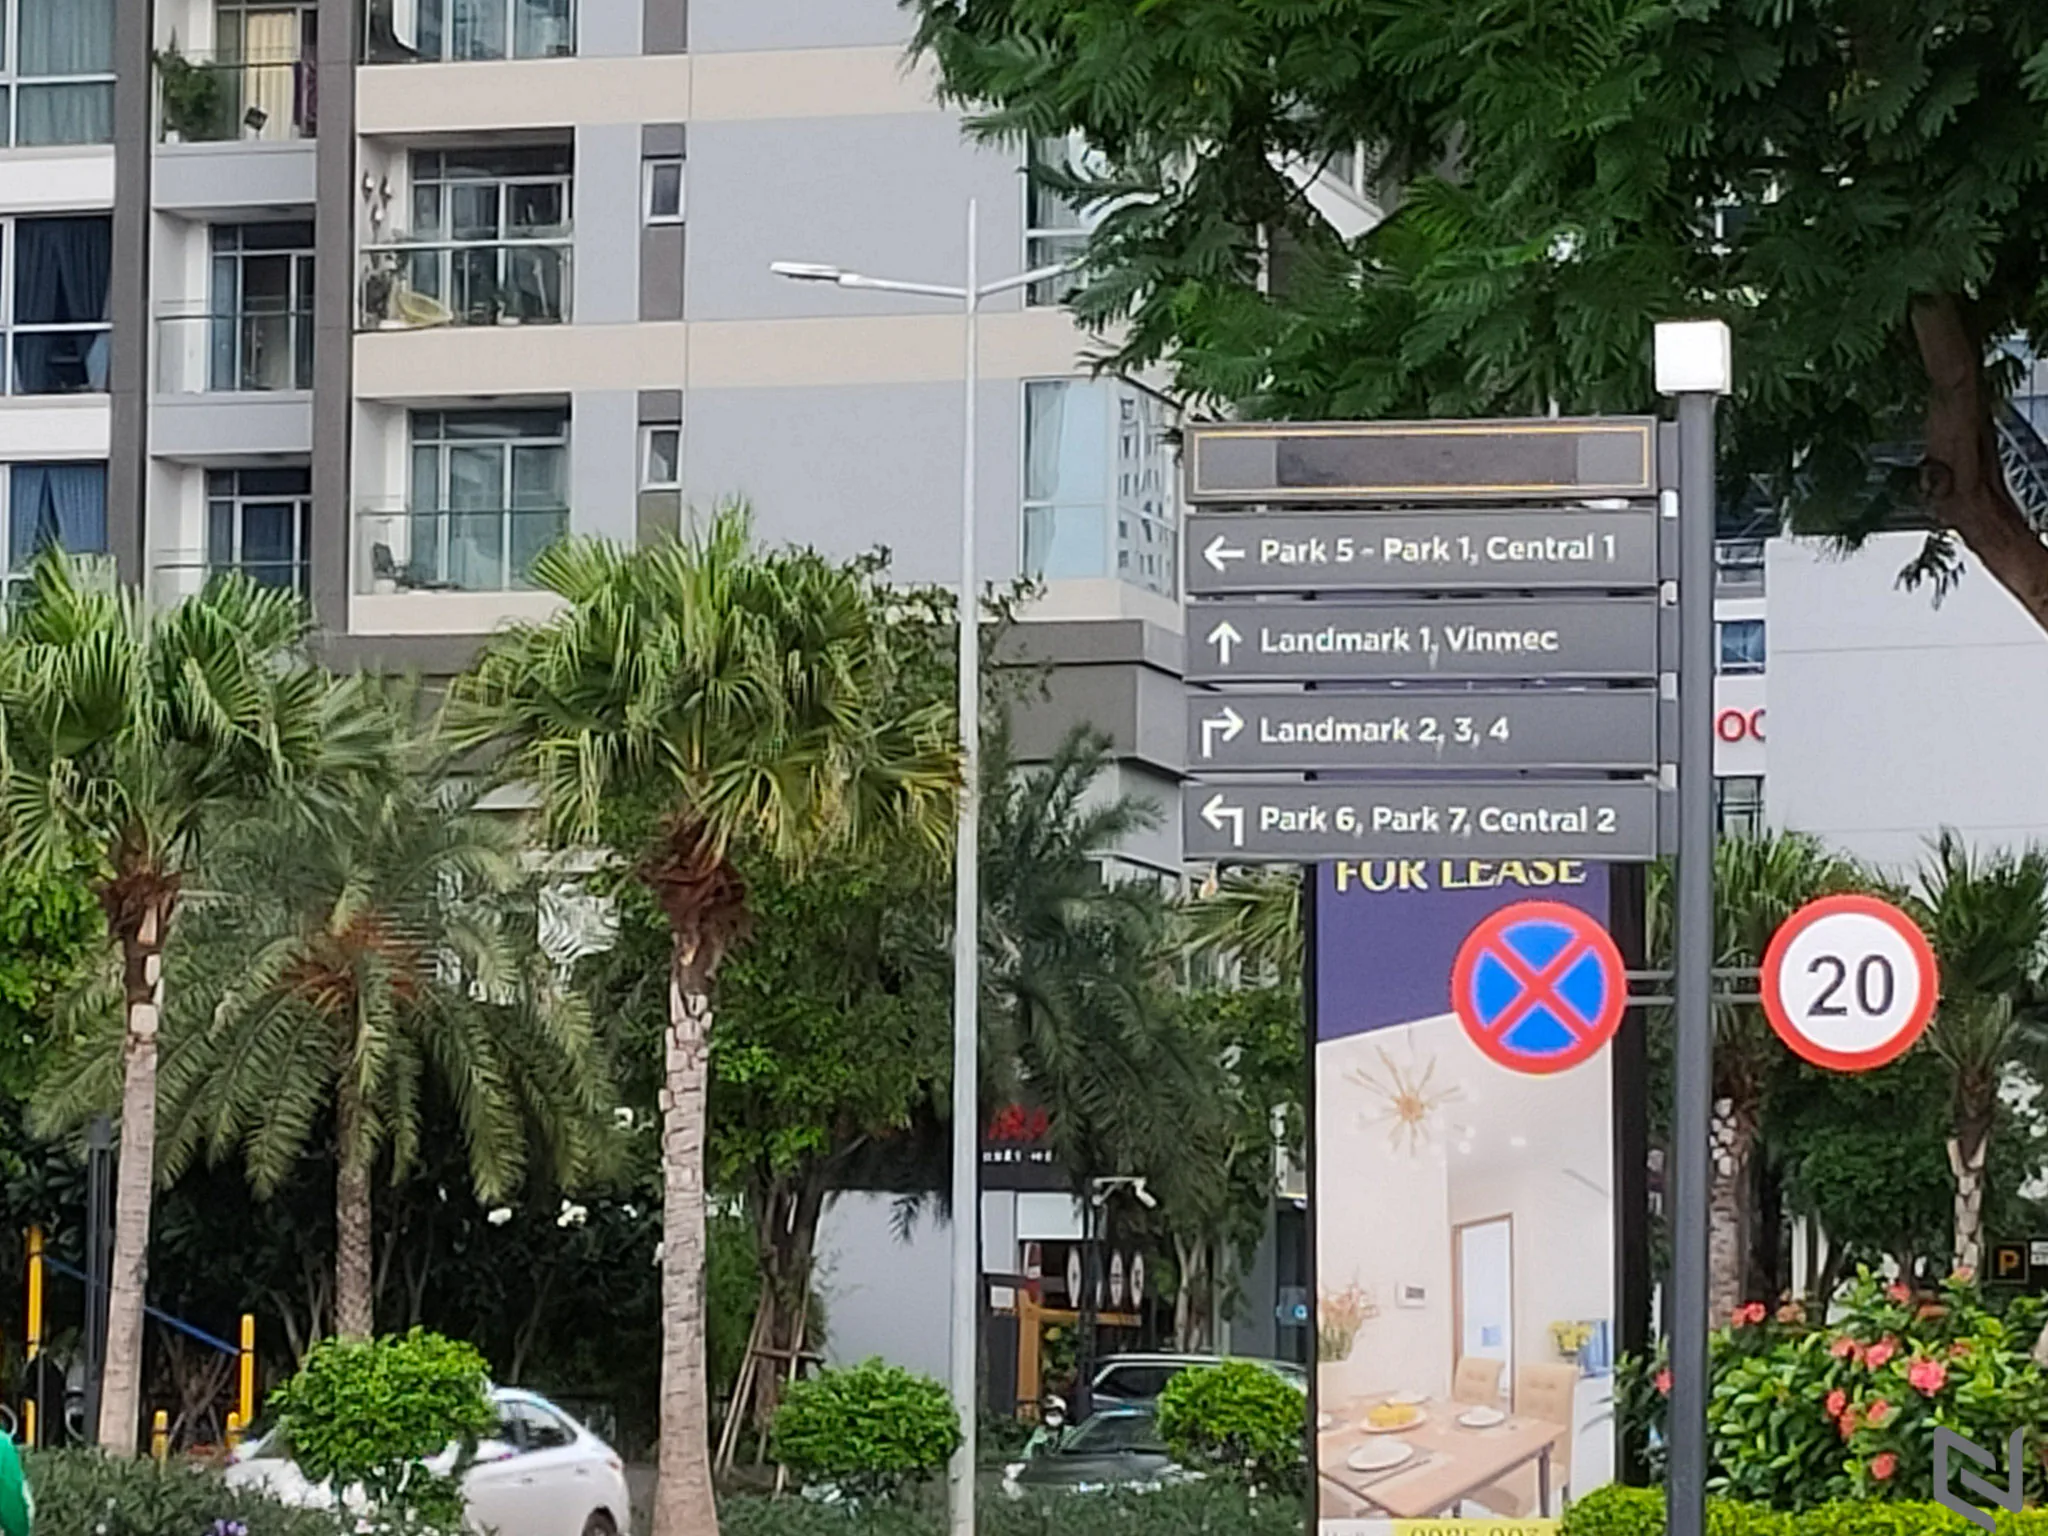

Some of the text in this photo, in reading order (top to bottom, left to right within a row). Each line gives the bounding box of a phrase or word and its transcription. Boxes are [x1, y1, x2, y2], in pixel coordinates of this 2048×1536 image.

[1261, 538, 1327, 563] Park
[1336, 538, 1354, 562] 5
[1384, 536, 1450, 562] Park
[1457, 536, 1479, 565] 1,
[1486, 535, 1594, 560] Central
[1603, 534, 1615, 560] 1
[1261, 625, 1559, 656] Landmark 1, Vinmec
[1261, 716, 1509, 748] Landmark 2, 3, 4
[1261, 805, 1616, 837] Park 6, Park 7, Central 2
[1336, 859, 1588, 892] FOR LEASE
[1806, 954, 1895, 1017] 20
